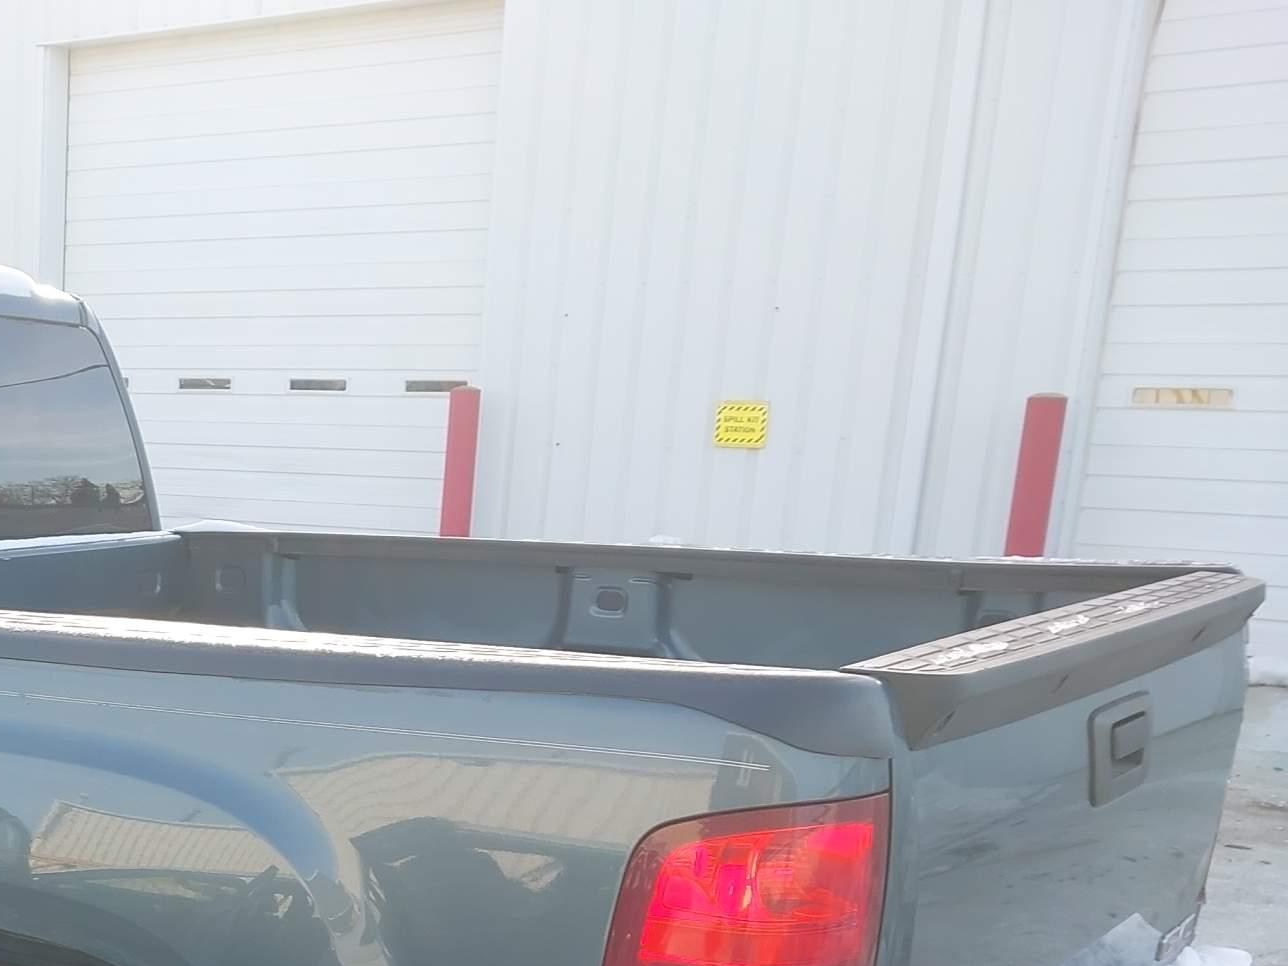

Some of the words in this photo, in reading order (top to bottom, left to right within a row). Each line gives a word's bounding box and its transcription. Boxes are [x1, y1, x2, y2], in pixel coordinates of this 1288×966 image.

[723, 415, 745, 423] SPILL
[746, 415, 760, 423] KIT
[724, 425, 756, 433] STATION
